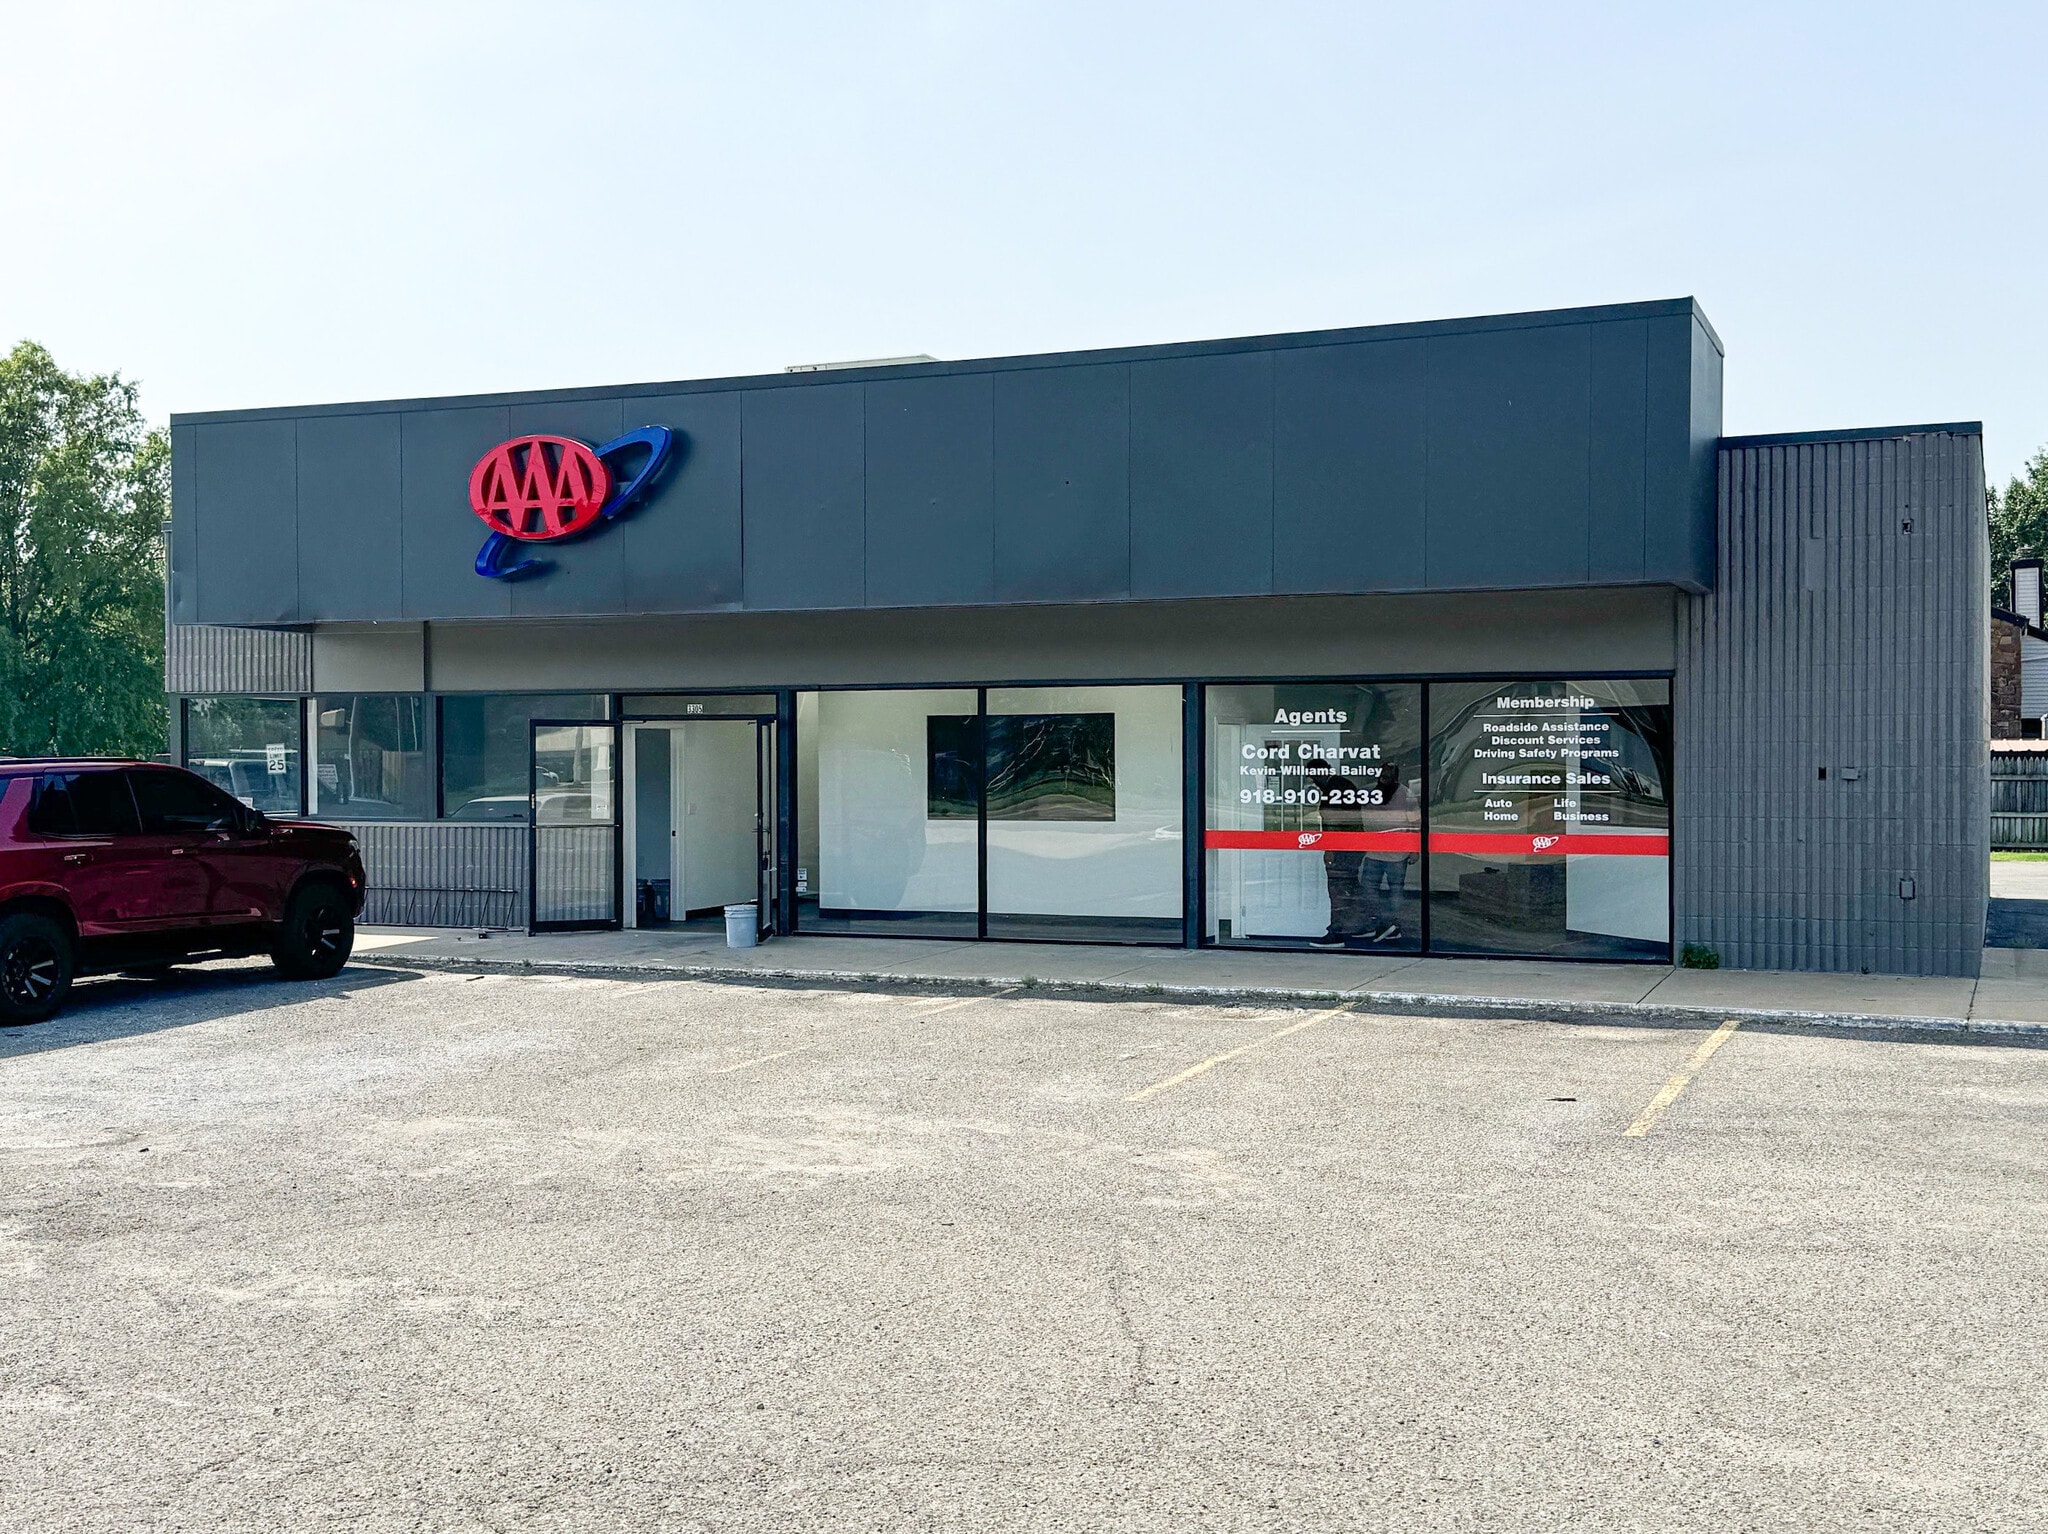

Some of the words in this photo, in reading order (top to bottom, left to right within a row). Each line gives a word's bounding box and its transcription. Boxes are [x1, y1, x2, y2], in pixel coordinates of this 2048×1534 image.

[480, 437, 598, 537] AAA
[1497, 696, 1594, 709] Membership
[1274, 708, 1347, 726] Agents
[1483, 723, 1538, 732] Roadside
[1542, 723, 1609, 731] Assistance
[1492, 736, 1544, 745] Discount
[1548, 736, 1601, 744] Services
[1242, 744, 1290, 759] Cord
[1298, 744, 1381, 759] Charvat
[1474, 749, 1515, 759] Driving
[1519, 749, 1557, 758] Safety
[1561, 749, 1619, 758] Programs
[269, 759, 284, 771] 25
[1240, 766, 1276, 775] Kevin
[1281, 766, 1336, 775] Williams
[1341, 766, 1382, 777] Bailey
[1482, 773, 1561, 784] Insurance
[1566, 773, 1610, 784] Sales
[1240, 790, 1383, 804] 918-910-2333
[1484, 799, 1512, 808] Auto
[1554, 799, 1576, 808] Life
[1484, 812, 1518, 821] Home
[1553, 812, 1609, 821] Business
